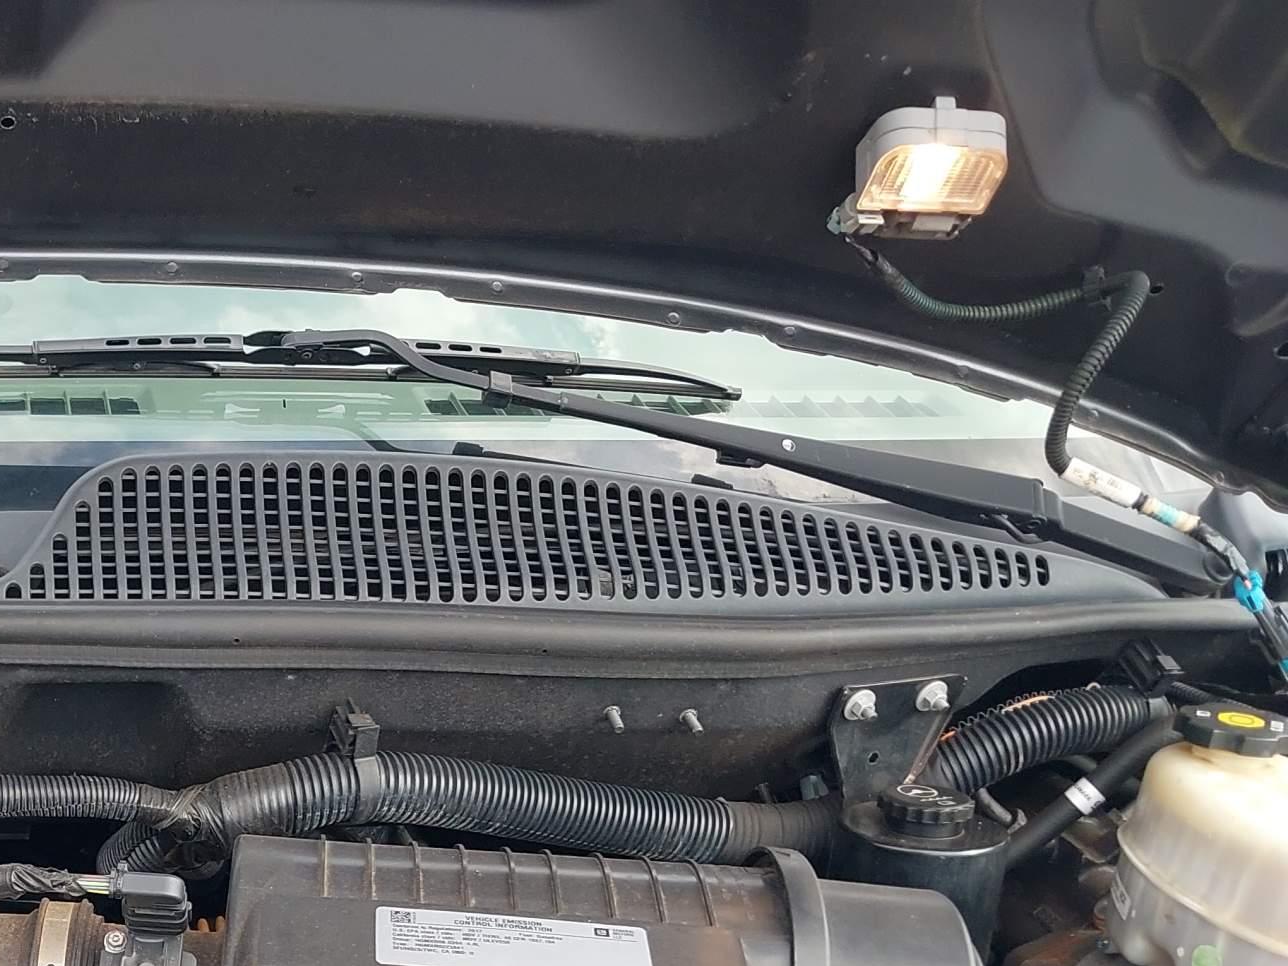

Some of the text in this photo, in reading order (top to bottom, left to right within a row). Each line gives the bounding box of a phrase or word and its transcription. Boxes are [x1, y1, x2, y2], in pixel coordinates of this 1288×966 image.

[454, 919, 553, 932] CONTROL INFORMATION
[464, 915, 543, 926] VEHICLE EMISSION
